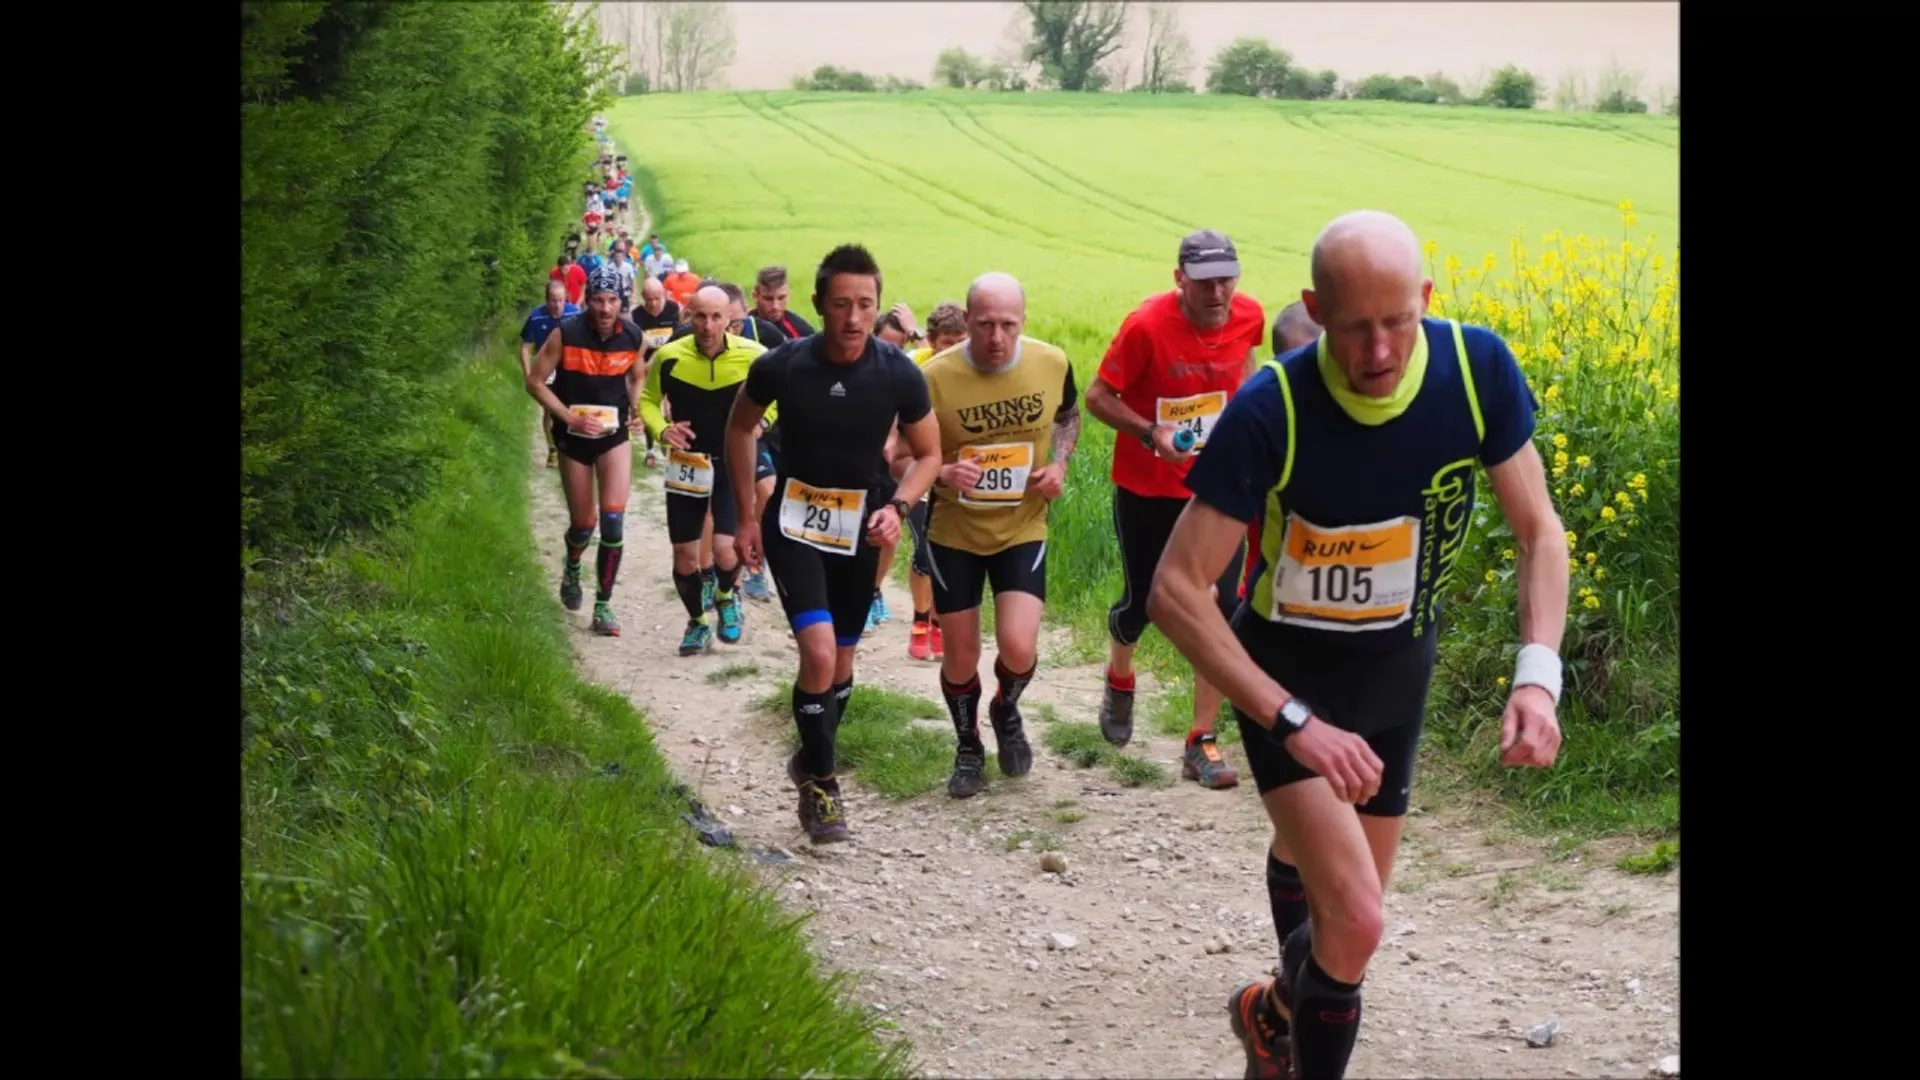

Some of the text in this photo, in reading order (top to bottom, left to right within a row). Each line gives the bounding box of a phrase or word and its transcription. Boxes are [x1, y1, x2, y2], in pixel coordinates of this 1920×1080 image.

[1169, 404, 1196, 416] RUN
[987, 411, 1026, 430] DAY
[679, 463, 695, 483] 54
[975, 467, 1013, 491] 296
[803, 504, 831, 532] 29
[1302, 539, 1355, 558] RUN
[1307, 564, 1374, 605] 105
